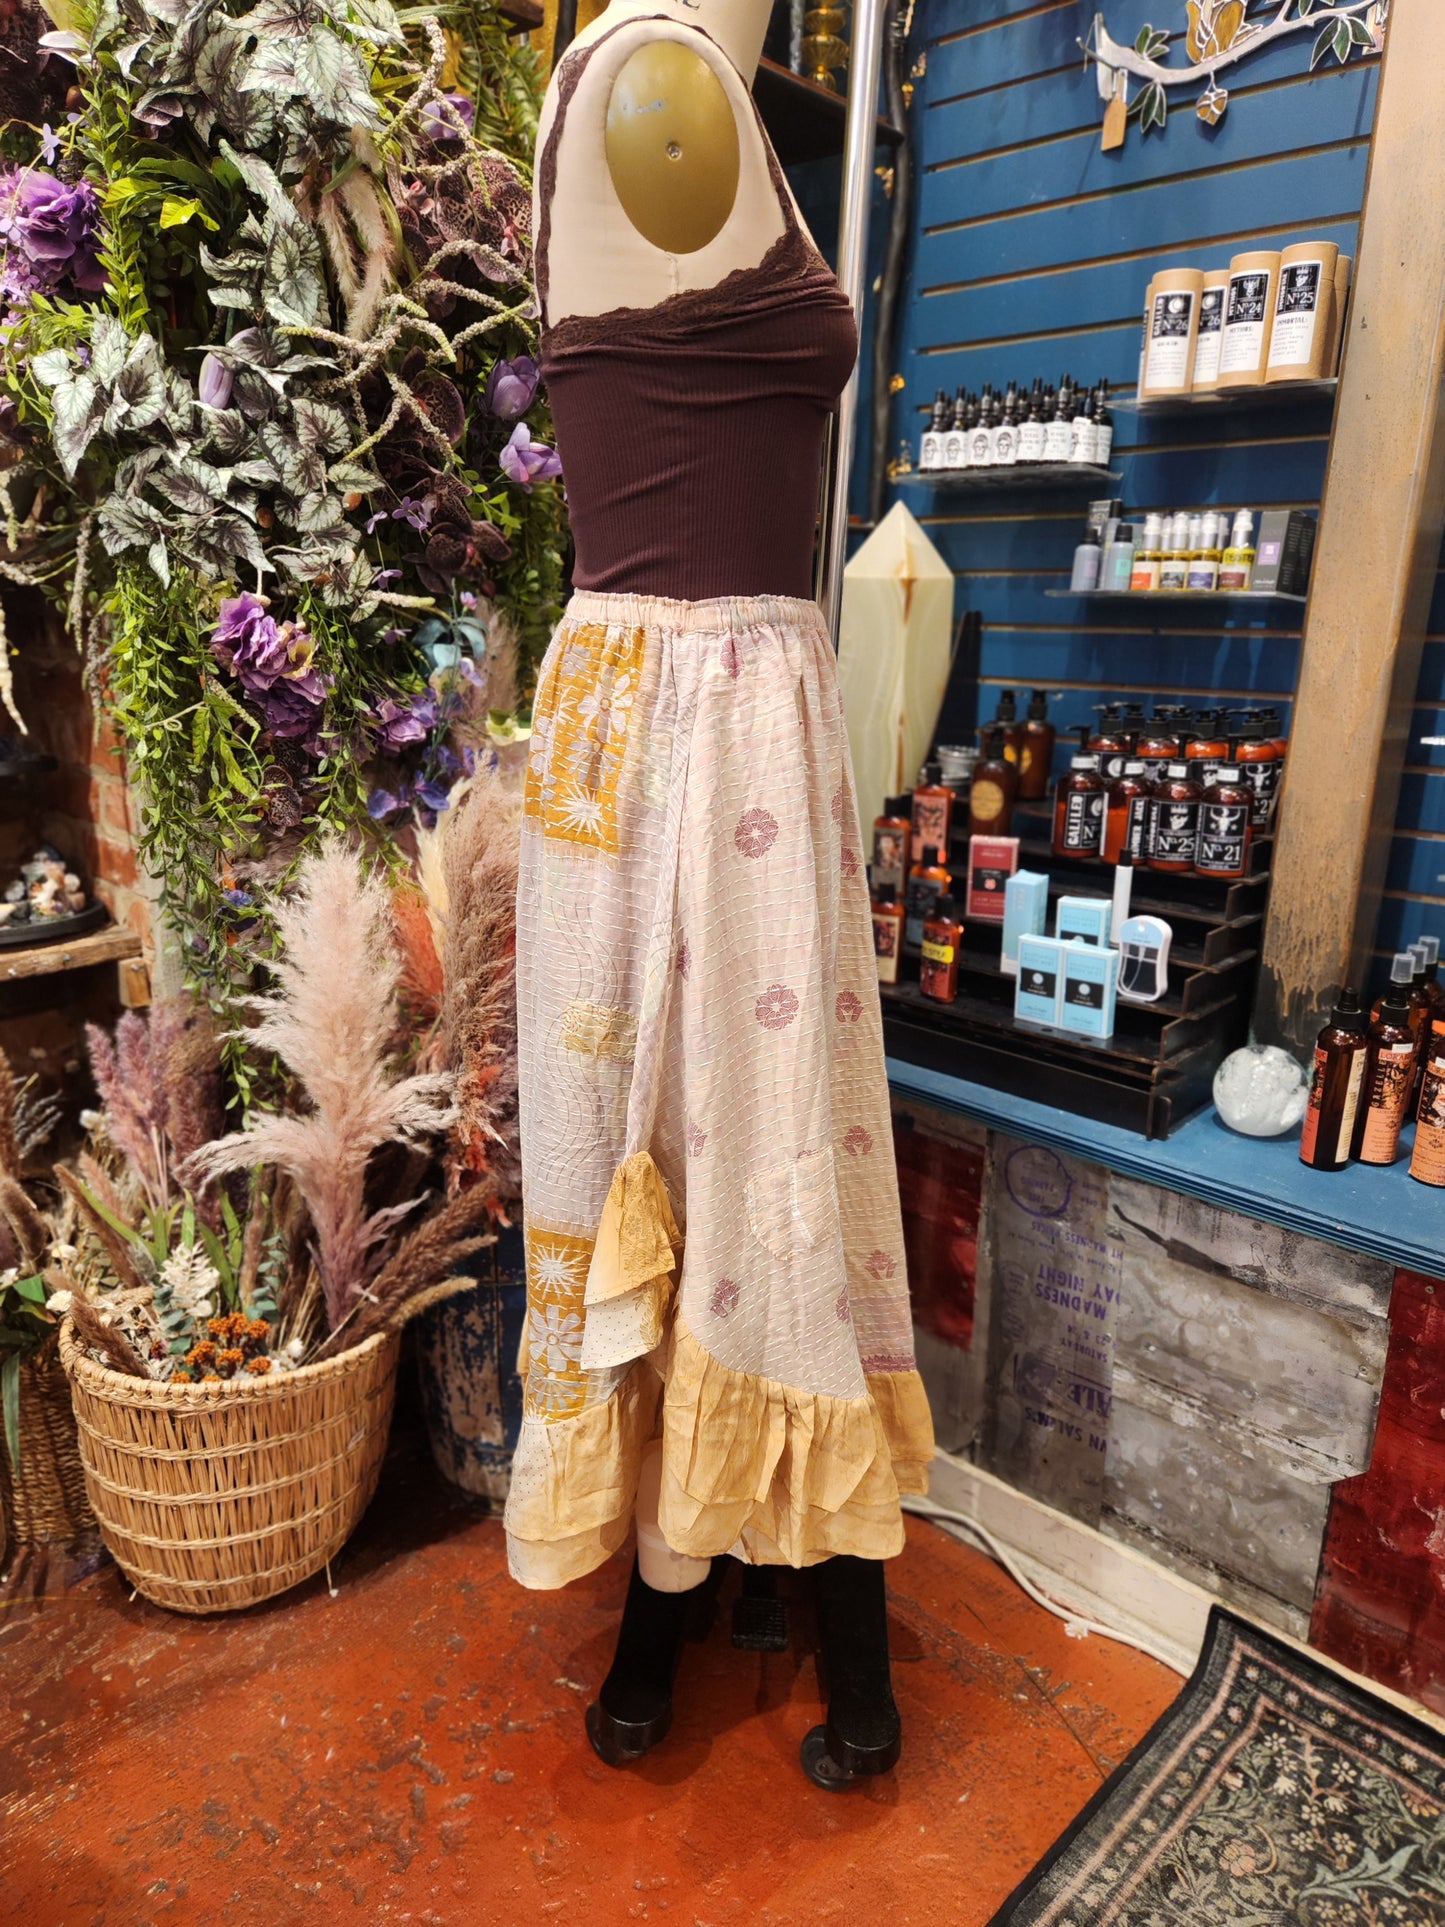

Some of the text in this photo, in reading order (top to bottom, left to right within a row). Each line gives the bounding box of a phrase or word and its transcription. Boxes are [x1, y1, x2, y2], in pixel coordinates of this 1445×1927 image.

[1300, 292, 1314, 304] 25
[1249, 302, 1261, 314] 24
[1175, 319, 1188, 330] 26
[1208, 315, 1220, 326] 26
[1134, 800, 1145, 821] JACK
[1067, 795, 1083, 846] GALILEO
[1178, 837, 1195, 852] 25
[1223, 844, 1241, 861] 21
[1371, 1060, 1386, 1107] GAZELLE
[1038, 1264, 1085, 1292] NIGHT
[1036, 1283, 1107, 1321] MADNESS
[1061, 1338, 1107, 1363] SATURDAY
